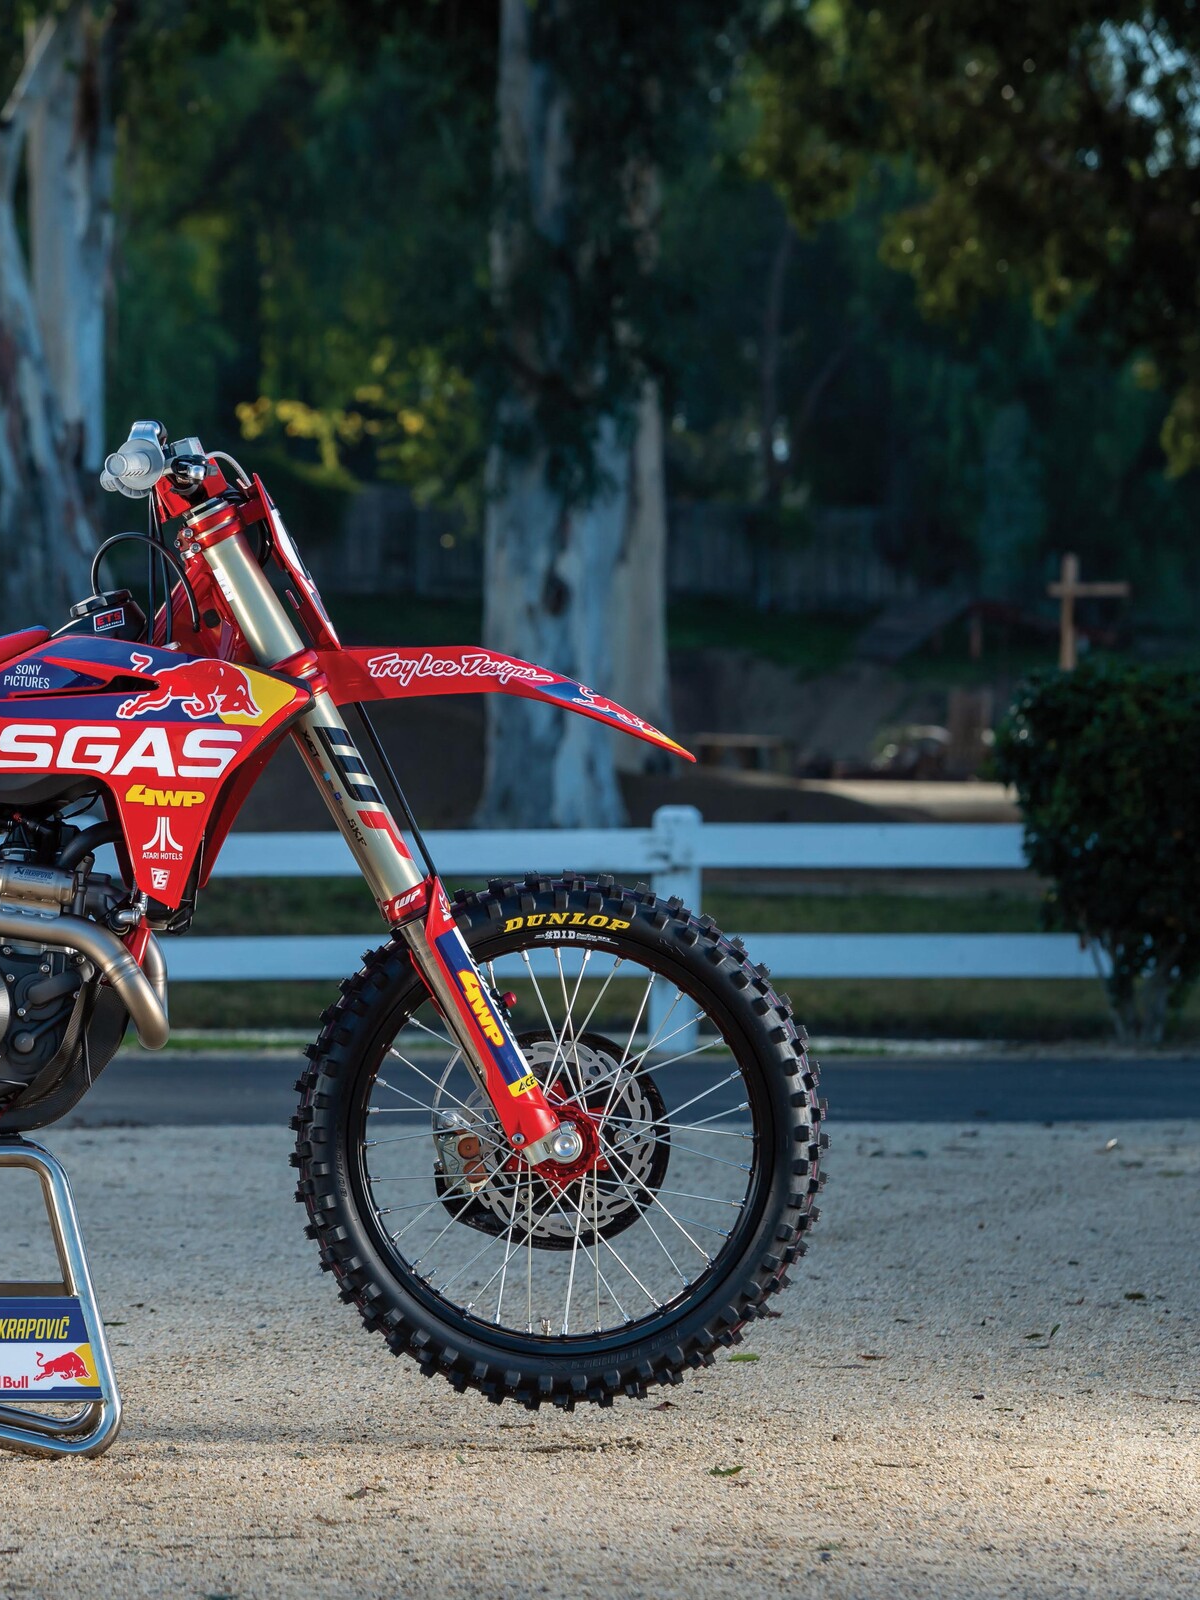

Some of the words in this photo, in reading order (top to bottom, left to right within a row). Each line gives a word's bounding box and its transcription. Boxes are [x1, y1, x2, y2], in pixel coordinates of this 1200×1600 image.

[96, 611, 121, 626] ETS
[15, 664, 42, 676] SONY
[368, 653, 418, 686] Troy
[416, 653, 460, 676] Lee
[461, 653, 554, 684] Designs
[3, 675, 50, 689] PICTURES
[125, 784, 205, 807] 4WP
[347, 818, 367, 846] SKF
[160, 852, 183, 860] HOTELS
[395, 888, 421, 910] WP
[503, 912, 630, 932] DUNLOP
[3, 1376, 29, 1388] Bull
